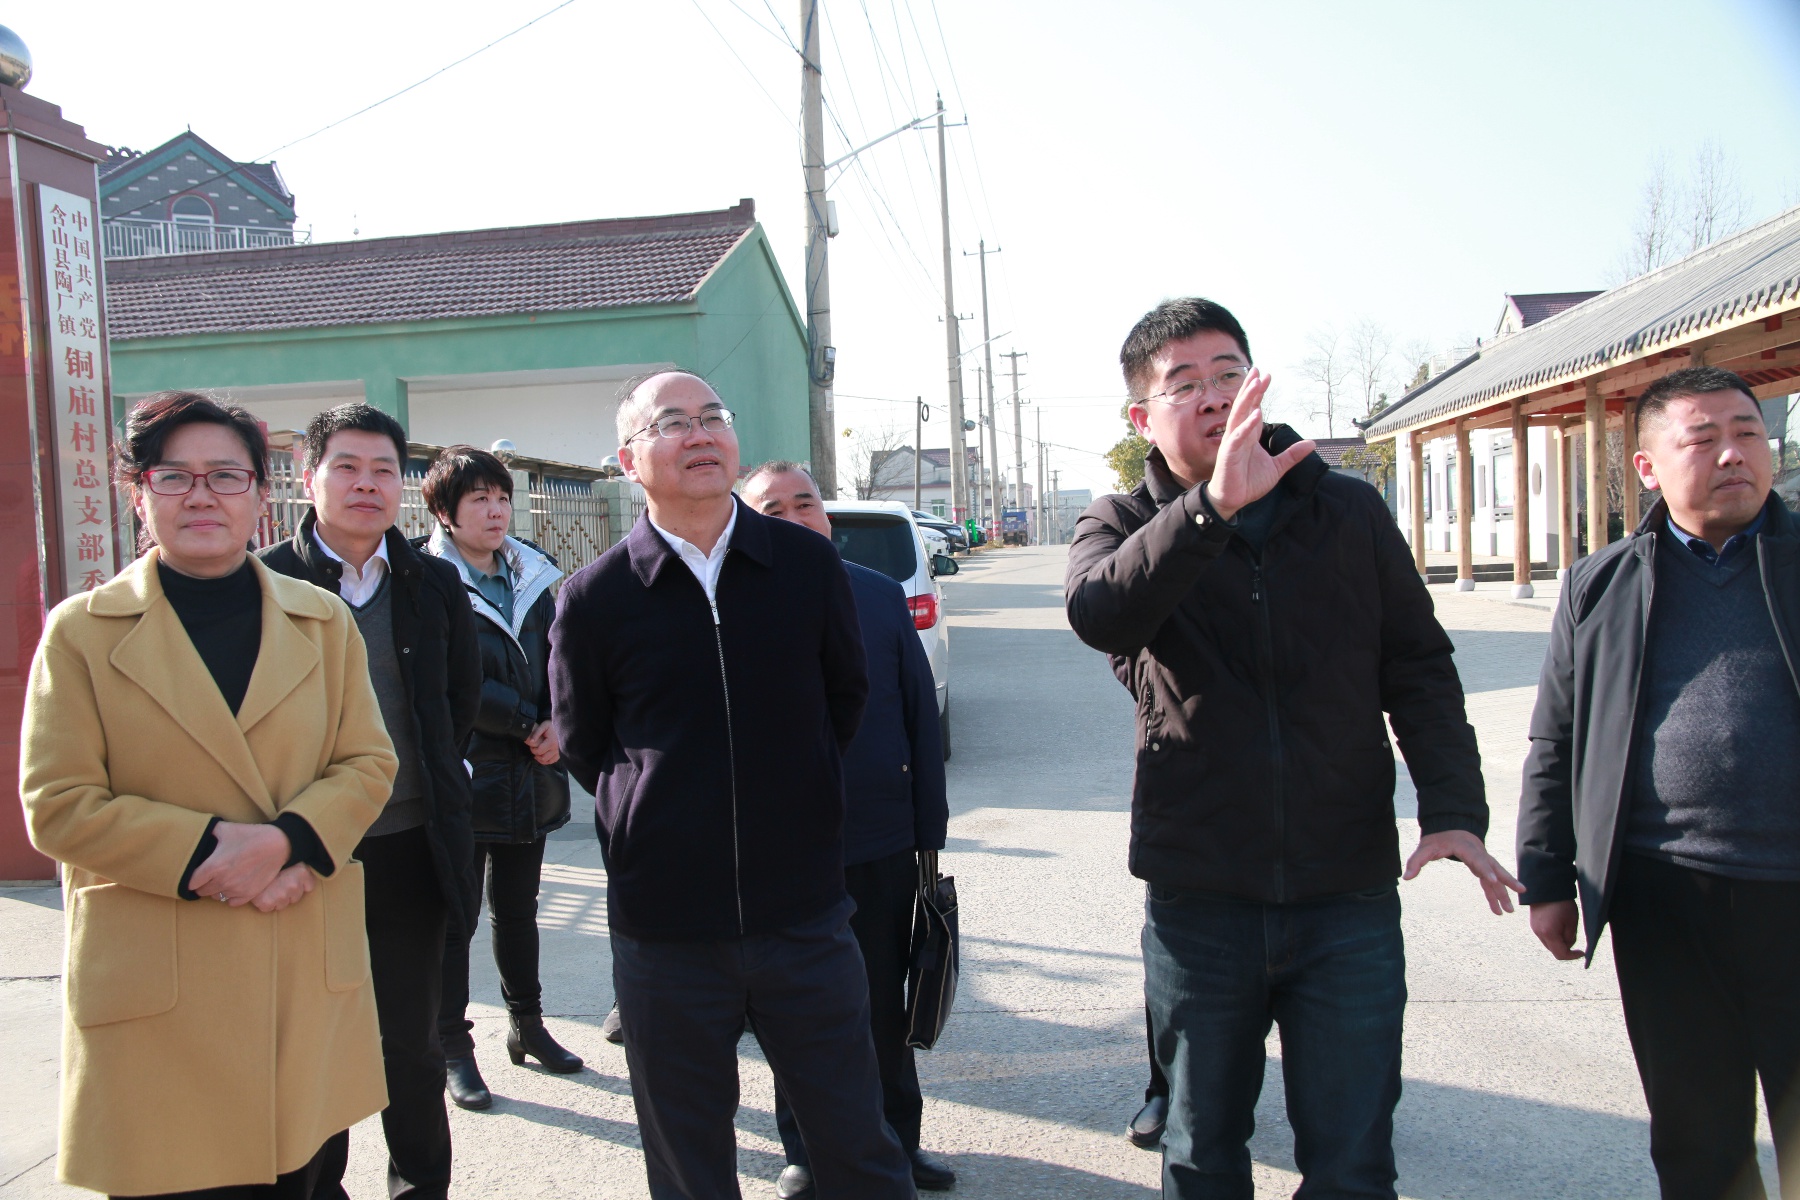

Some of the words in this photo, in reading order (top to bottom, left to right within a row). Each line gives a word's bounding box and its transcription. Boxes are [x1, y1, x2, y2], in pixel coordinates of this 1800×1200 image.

[50, 204, 76, 336] 含山县陶厂镇
[72, 210, 97, 339] 中国共产党
